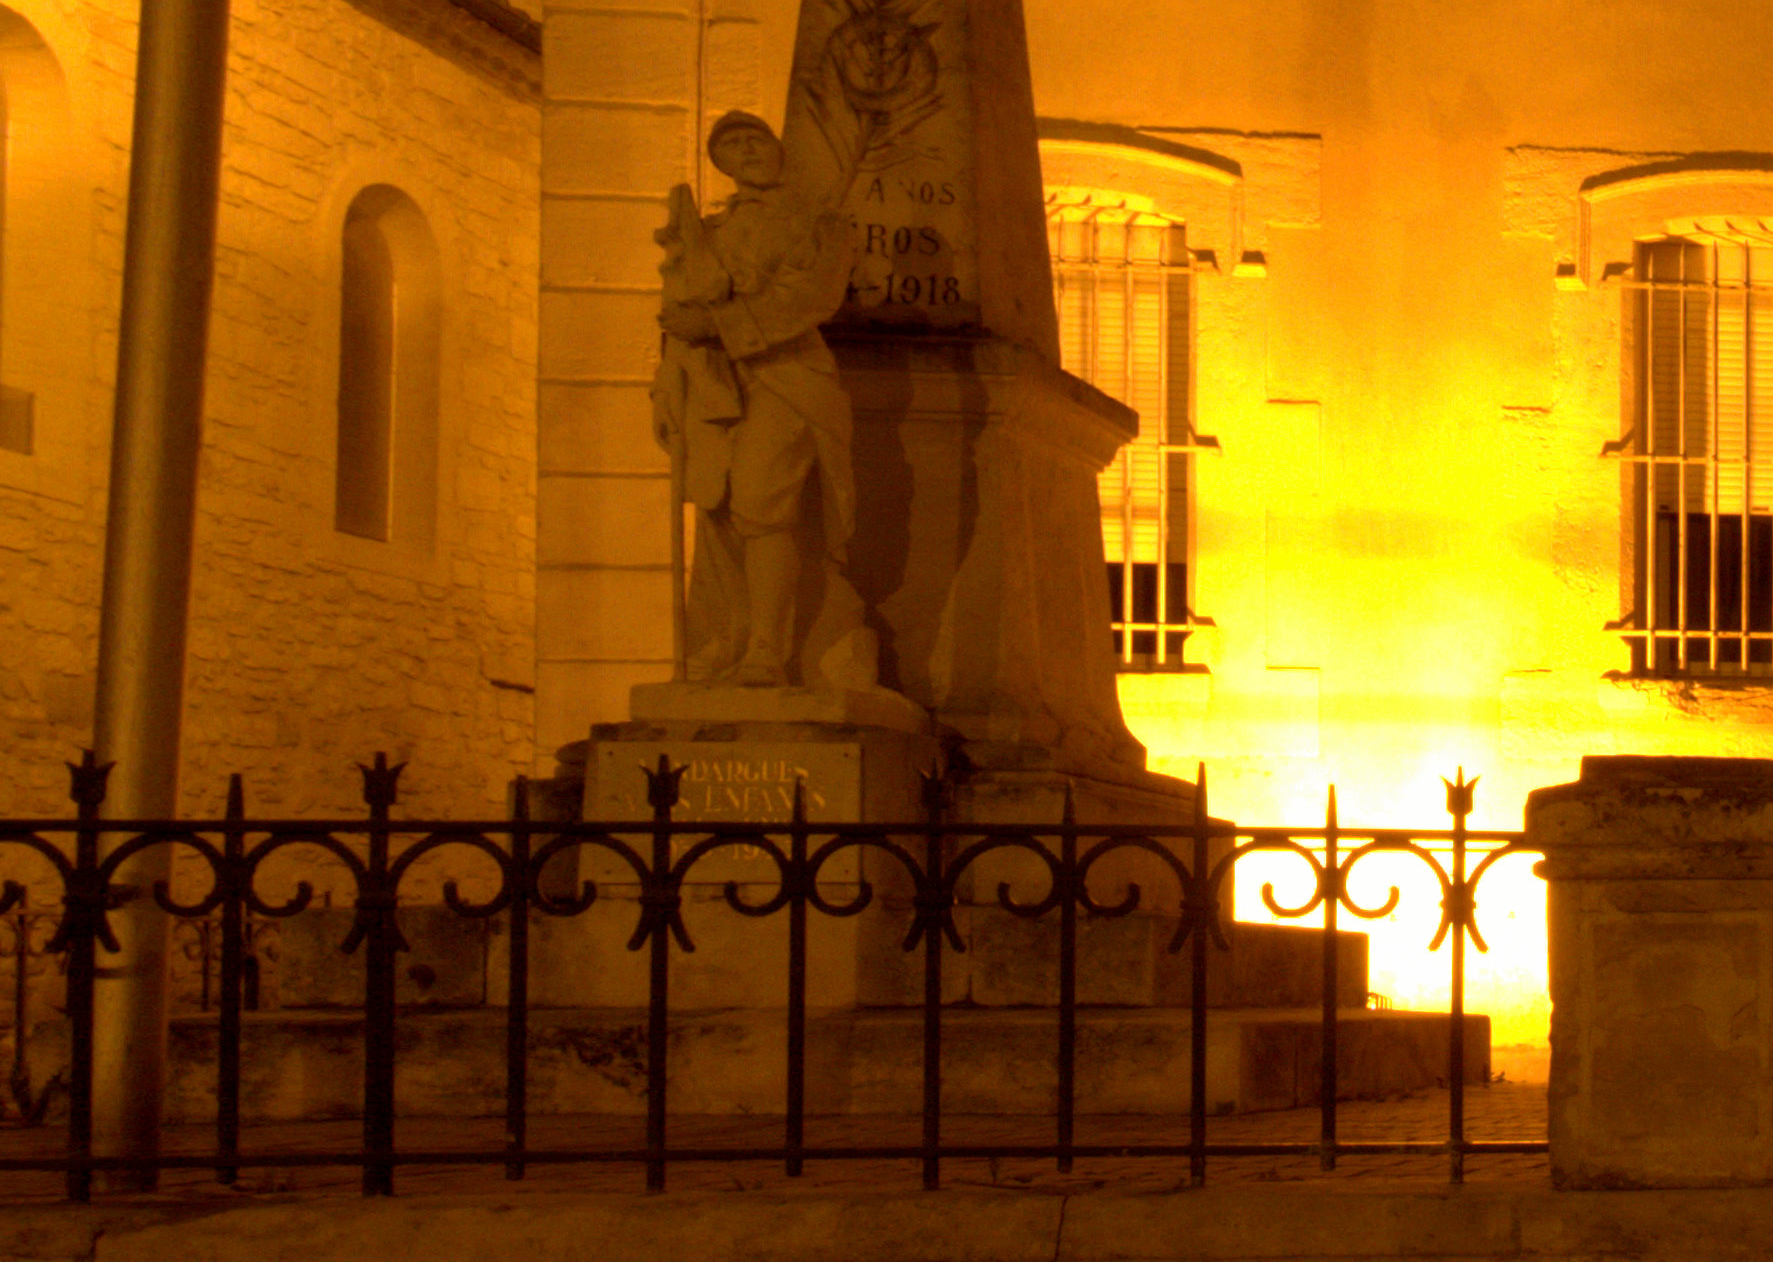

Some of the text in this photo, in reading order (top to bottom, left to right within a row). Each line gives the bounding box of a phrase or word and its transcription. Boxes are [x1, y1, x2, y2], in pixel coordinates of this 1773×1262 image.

[864, 176, 956, 205] A NOS
[851, 221, 941, 259] ROS
